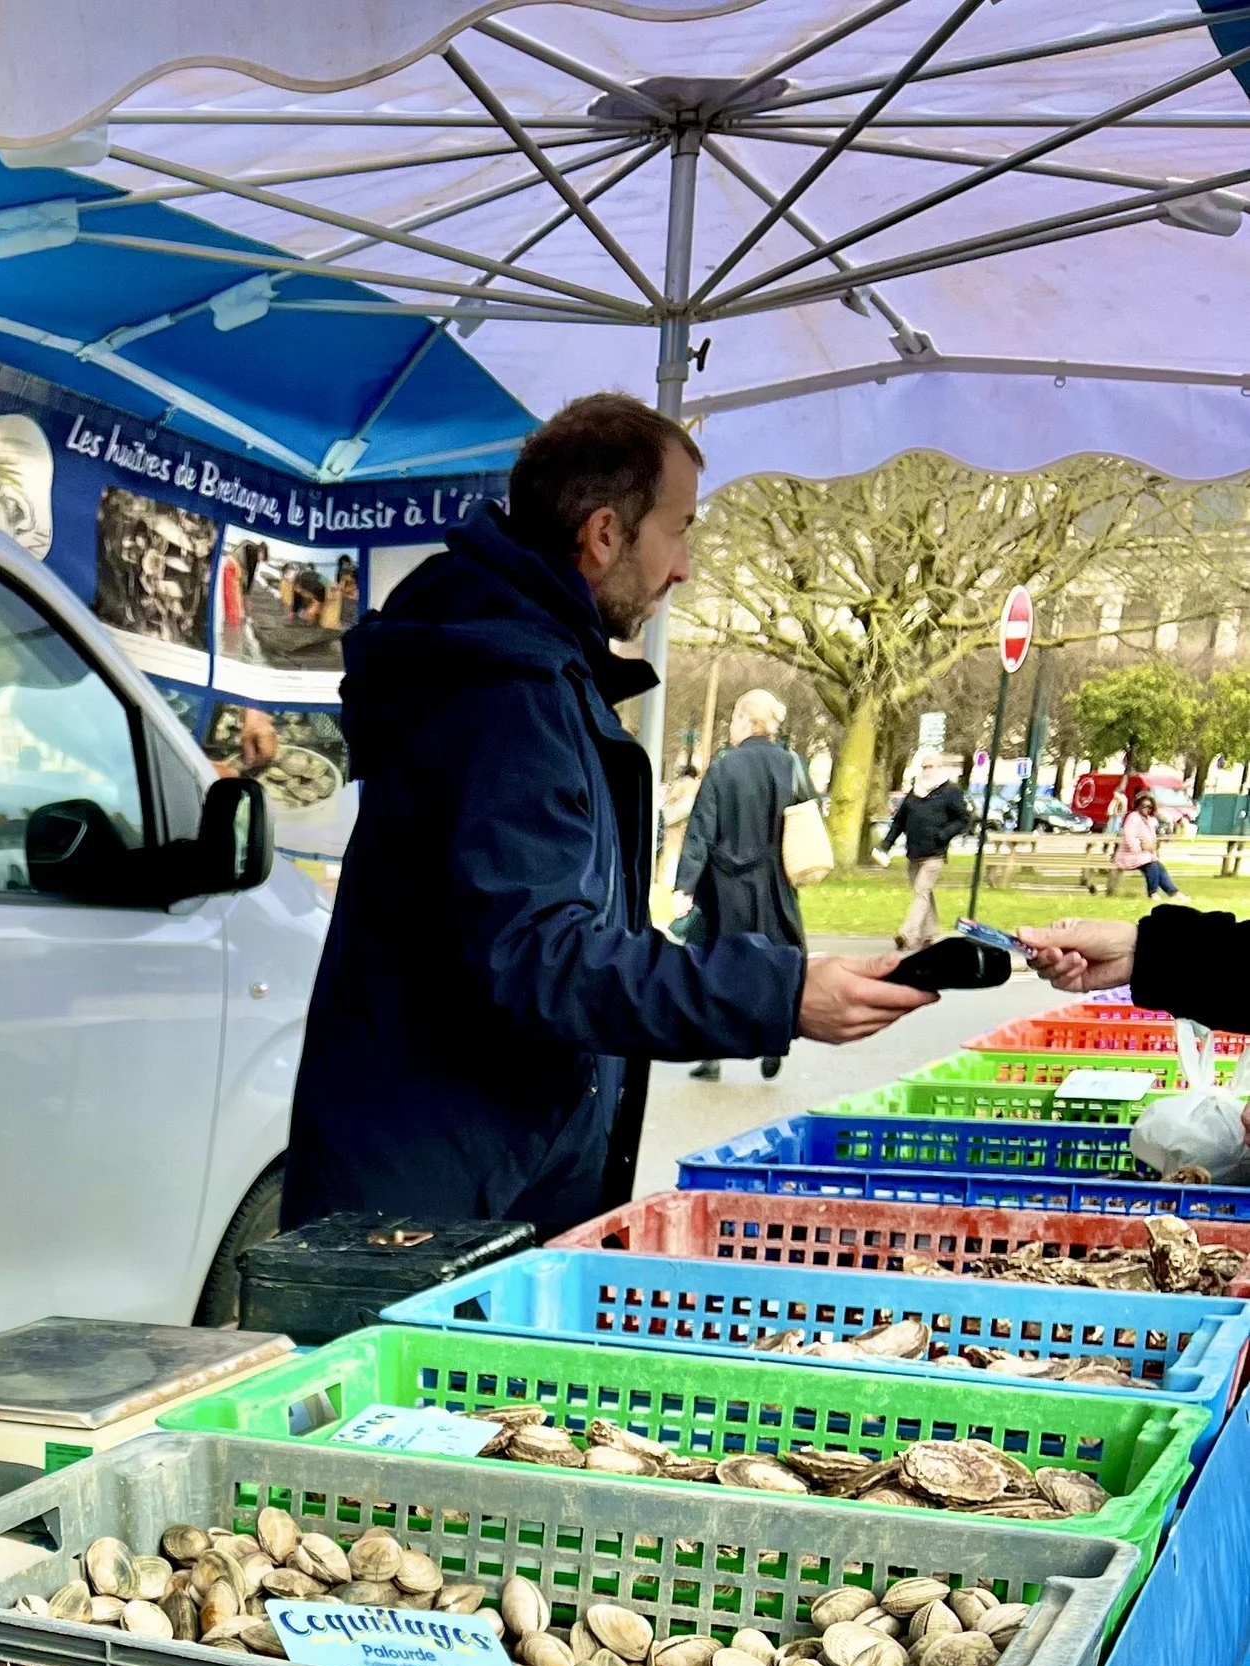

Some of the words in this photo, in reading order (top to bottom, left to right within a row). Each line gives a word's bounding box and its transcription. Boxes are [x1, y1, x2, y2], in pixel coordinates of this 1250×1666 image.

[66, 414, 105, 457] Les
[174, 451, 197, 490] de
[199, 460, 281, 525] Bretagne,
[287, 489, 305, 526] le
[308, 497, 397, 541] plaisir
[404, 498, 426, 527] à
[278, 1608, 492, 1652] Coquillages
[361, 1644, 438, 1662] Palourde
